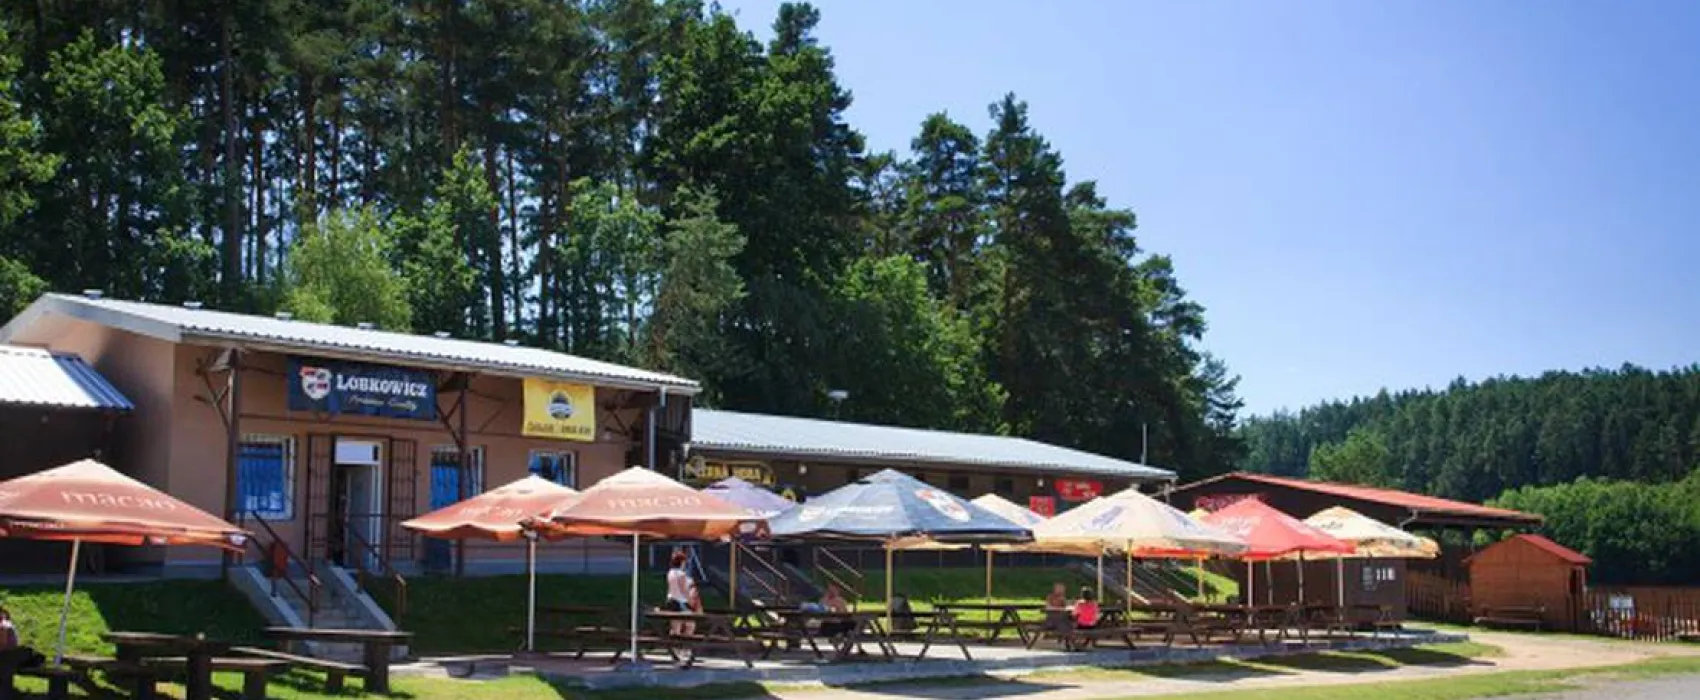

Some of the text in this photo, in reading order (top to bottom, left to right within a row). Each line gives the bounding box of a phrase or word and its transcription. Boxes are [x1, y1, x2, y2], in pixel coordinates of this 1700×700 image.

[336, 374, 428, 397] LOBKOWICZ
[60, 490, 176, 511] macao
[606, 495, 702, 511] macao
